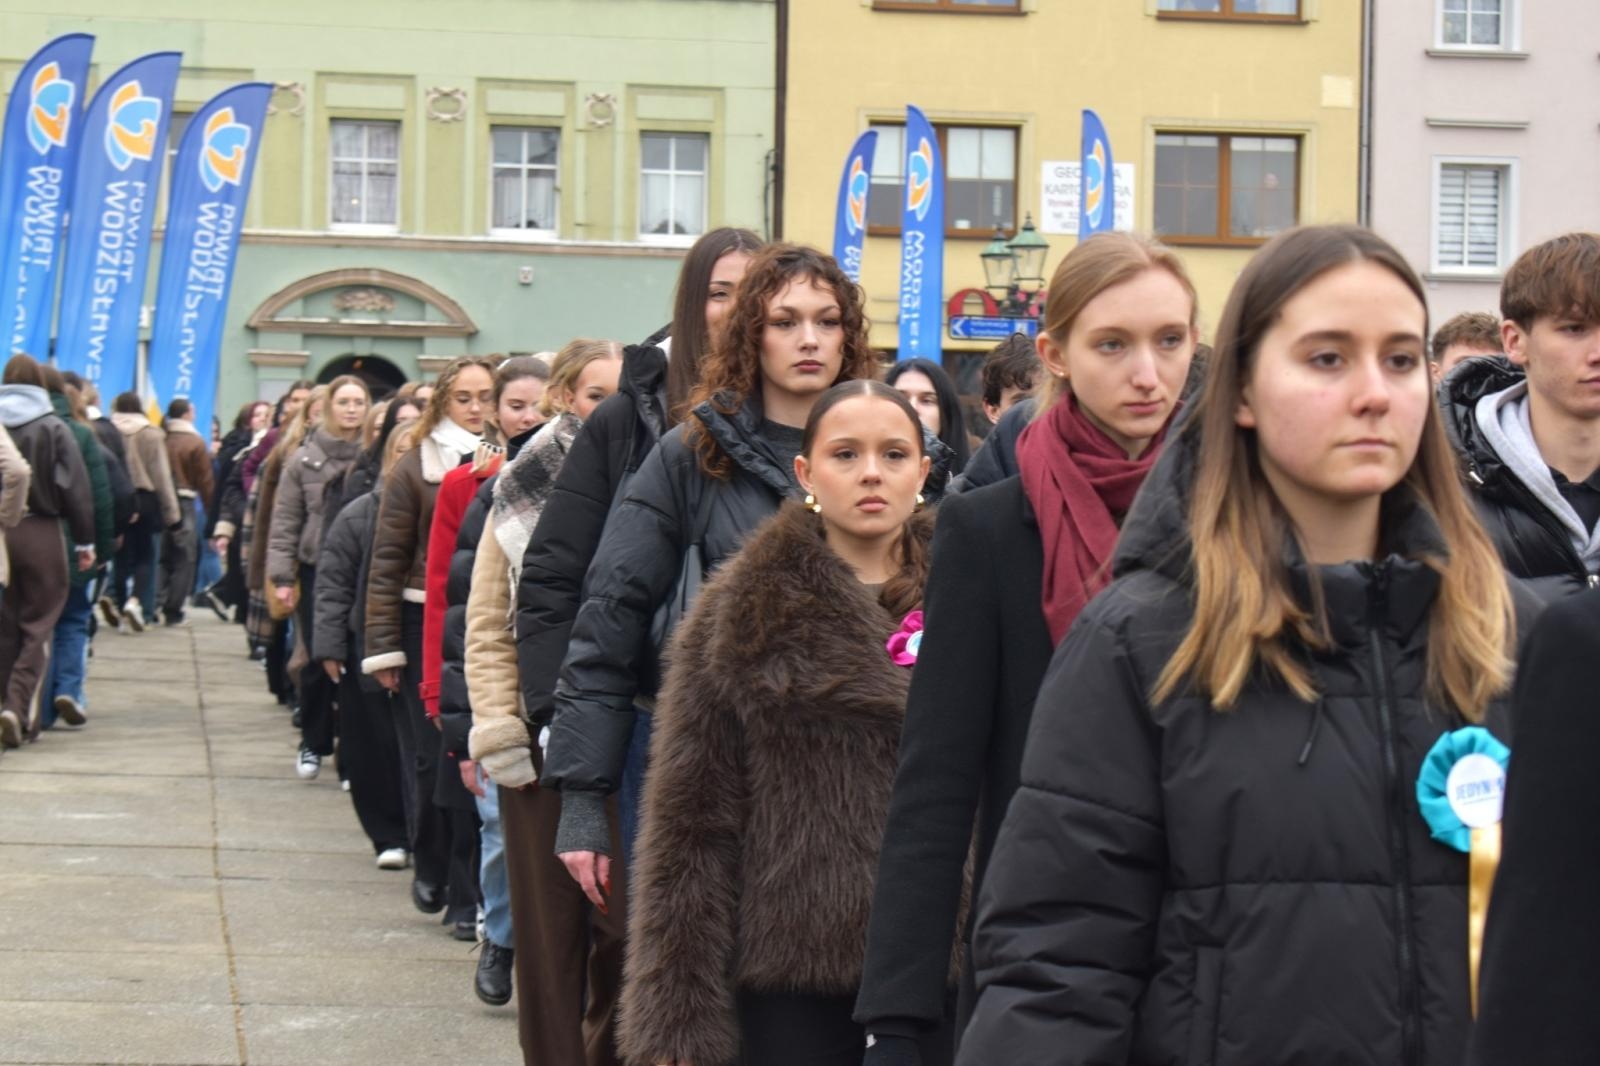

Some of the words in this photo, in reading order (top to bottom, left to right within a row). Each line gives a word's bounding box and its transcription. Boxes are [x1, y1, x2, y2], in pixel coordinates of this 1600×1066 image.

[31, 165, 63, 272] POWIAT
[119, 181, 147, 284] POWIAT
[204, 203, 237, 301] POWIAT
